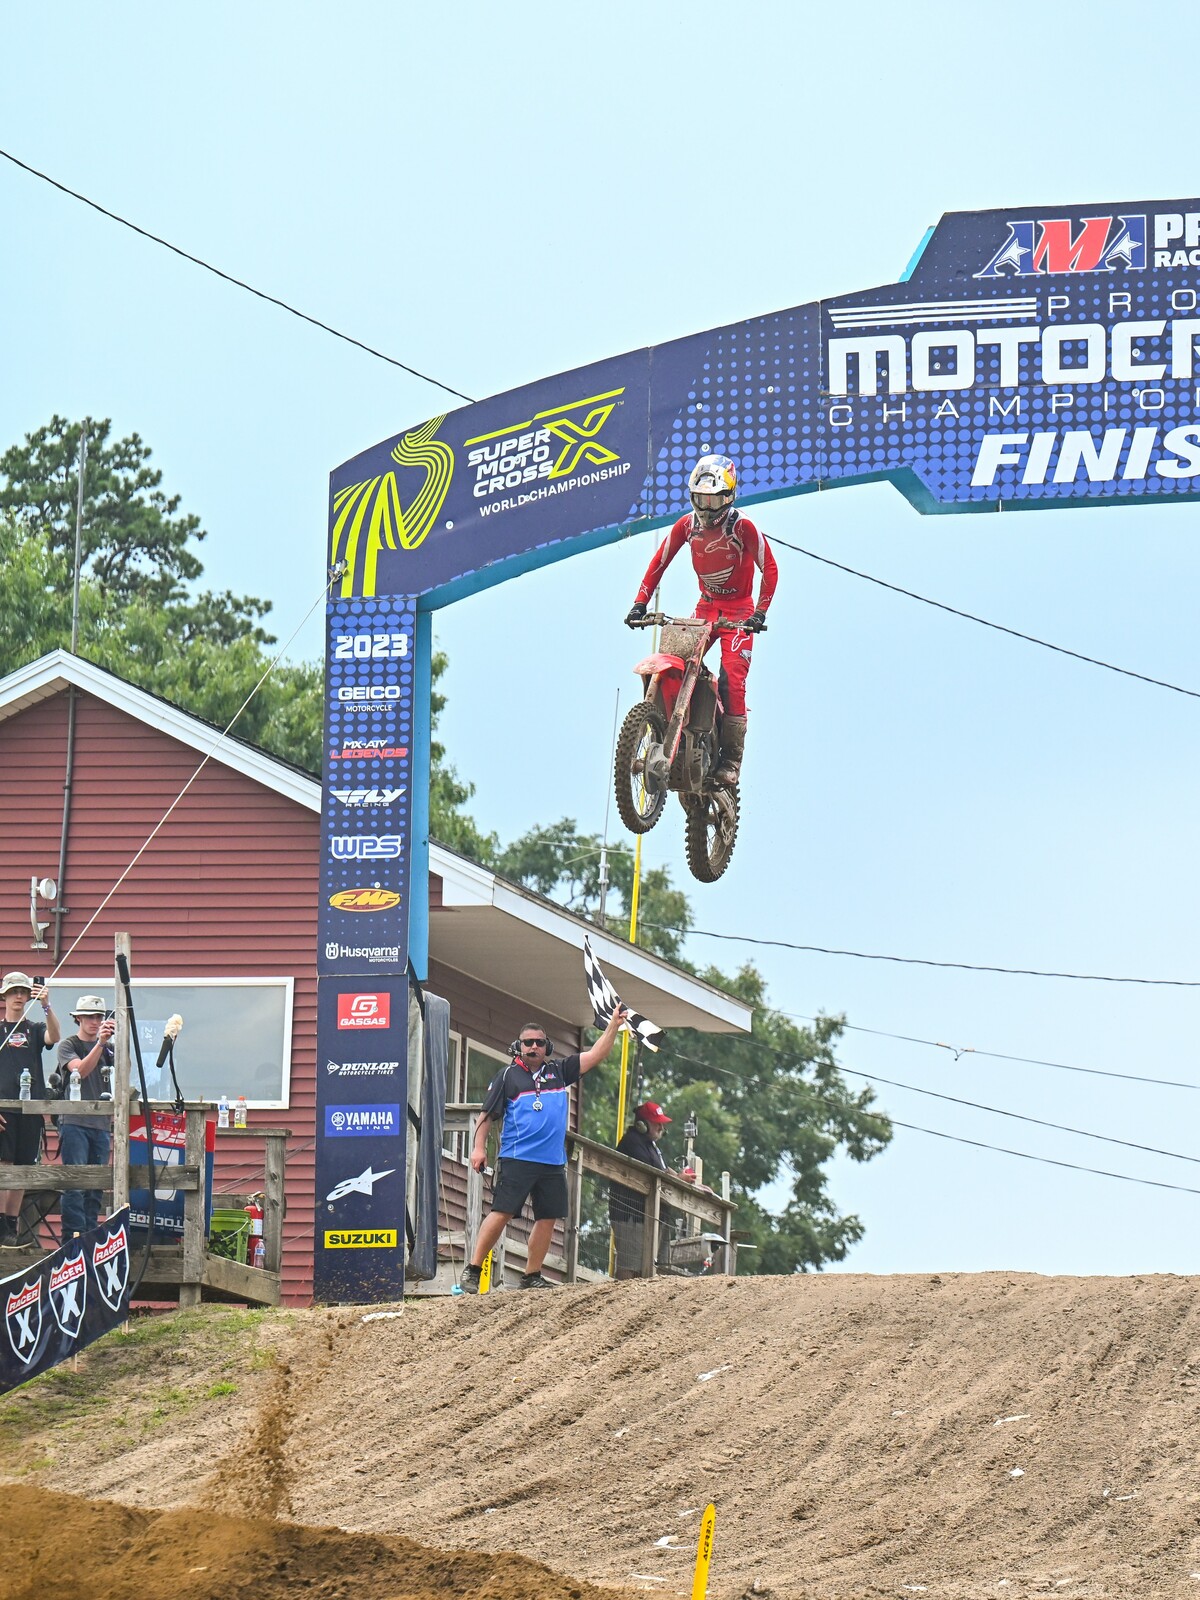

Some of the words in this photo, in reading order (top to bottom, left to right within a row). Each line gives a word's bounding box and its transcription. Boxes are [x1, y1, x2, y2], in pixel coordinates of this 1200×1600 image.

[972, 214, 1147, 279] AMA
[1047, 289, 1198, 317] PRO
[468, 428, 551, 467] SUPER
[476, 445, 550, 481] MOTO
[473, 460, 554, 498] CROSS
[479, 493, 527, 517] WORLD
[529, 462, 631, 502] CHAMPIONSHIP
[335, 633, 409, 659] 2023
[338, 685, 401, 700] GEICO
[345, 704, 392, 712] MOTORCYCLE
[330, 748, 408, 760] LEGENDS
[342, 739, 388, 750] MX-ATV
[329, 788, 408, 804] FLY
[332, 836, 401, 859] WPS
[329, 891, 401, 907] FMF
[340, 945, 399, 959] Husqvarna
[340, 1017, 387, 1026] GASGAS
[340, 1062, 400, 1071] DUNLOP
[345, 1111, 394, 1126] YAMAHA
[95, 1237, 124, 1262] RACER
[329, 1233, 391, 1244] SUZUKI
[51, 1264, 84, 1288] RACER
[104, 1256, 123, 1298] X
[9, 1289, 39, 1311] RACER
[60, 1281, 81, 1324] X
[15, 1306, 36, 1350] X
